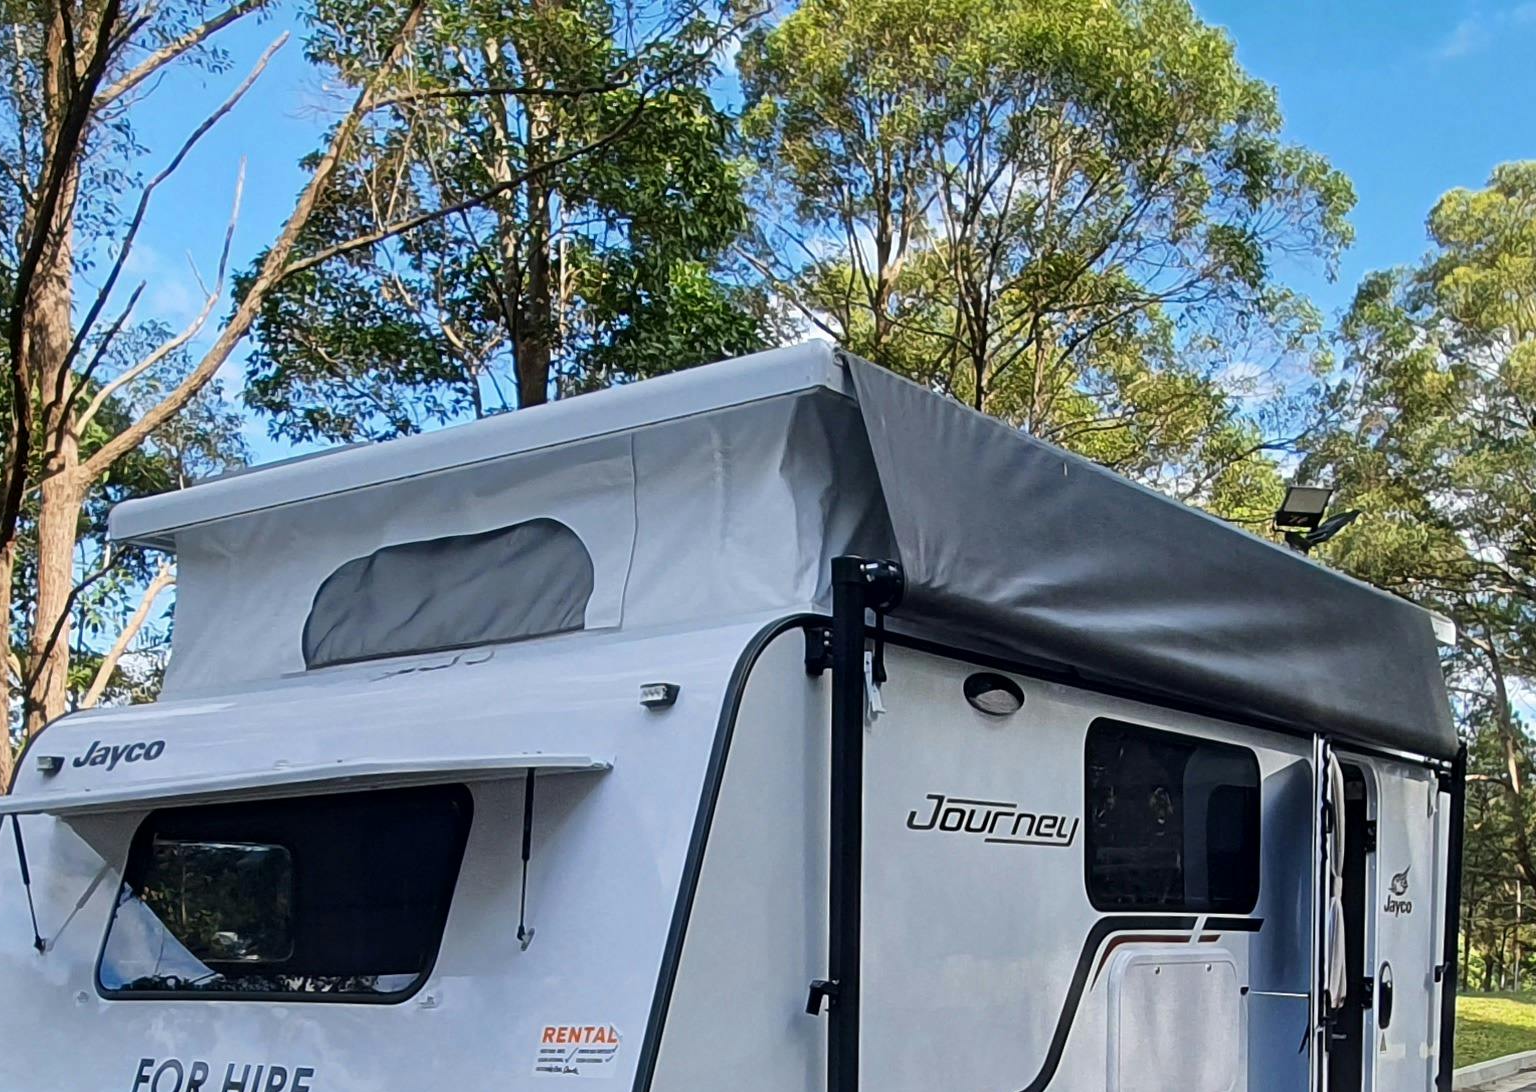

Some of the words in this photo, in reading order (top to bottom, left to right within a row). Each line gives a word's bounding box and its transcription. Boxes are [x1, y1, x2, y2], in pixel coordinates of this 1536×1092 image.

[72, 739, 166, 772] Jayco
[906, 794, 1080, 847] Journey
[1383, 894, 1413, 918] Jayco
[542, 1025, 618, 1044] RENTAL
